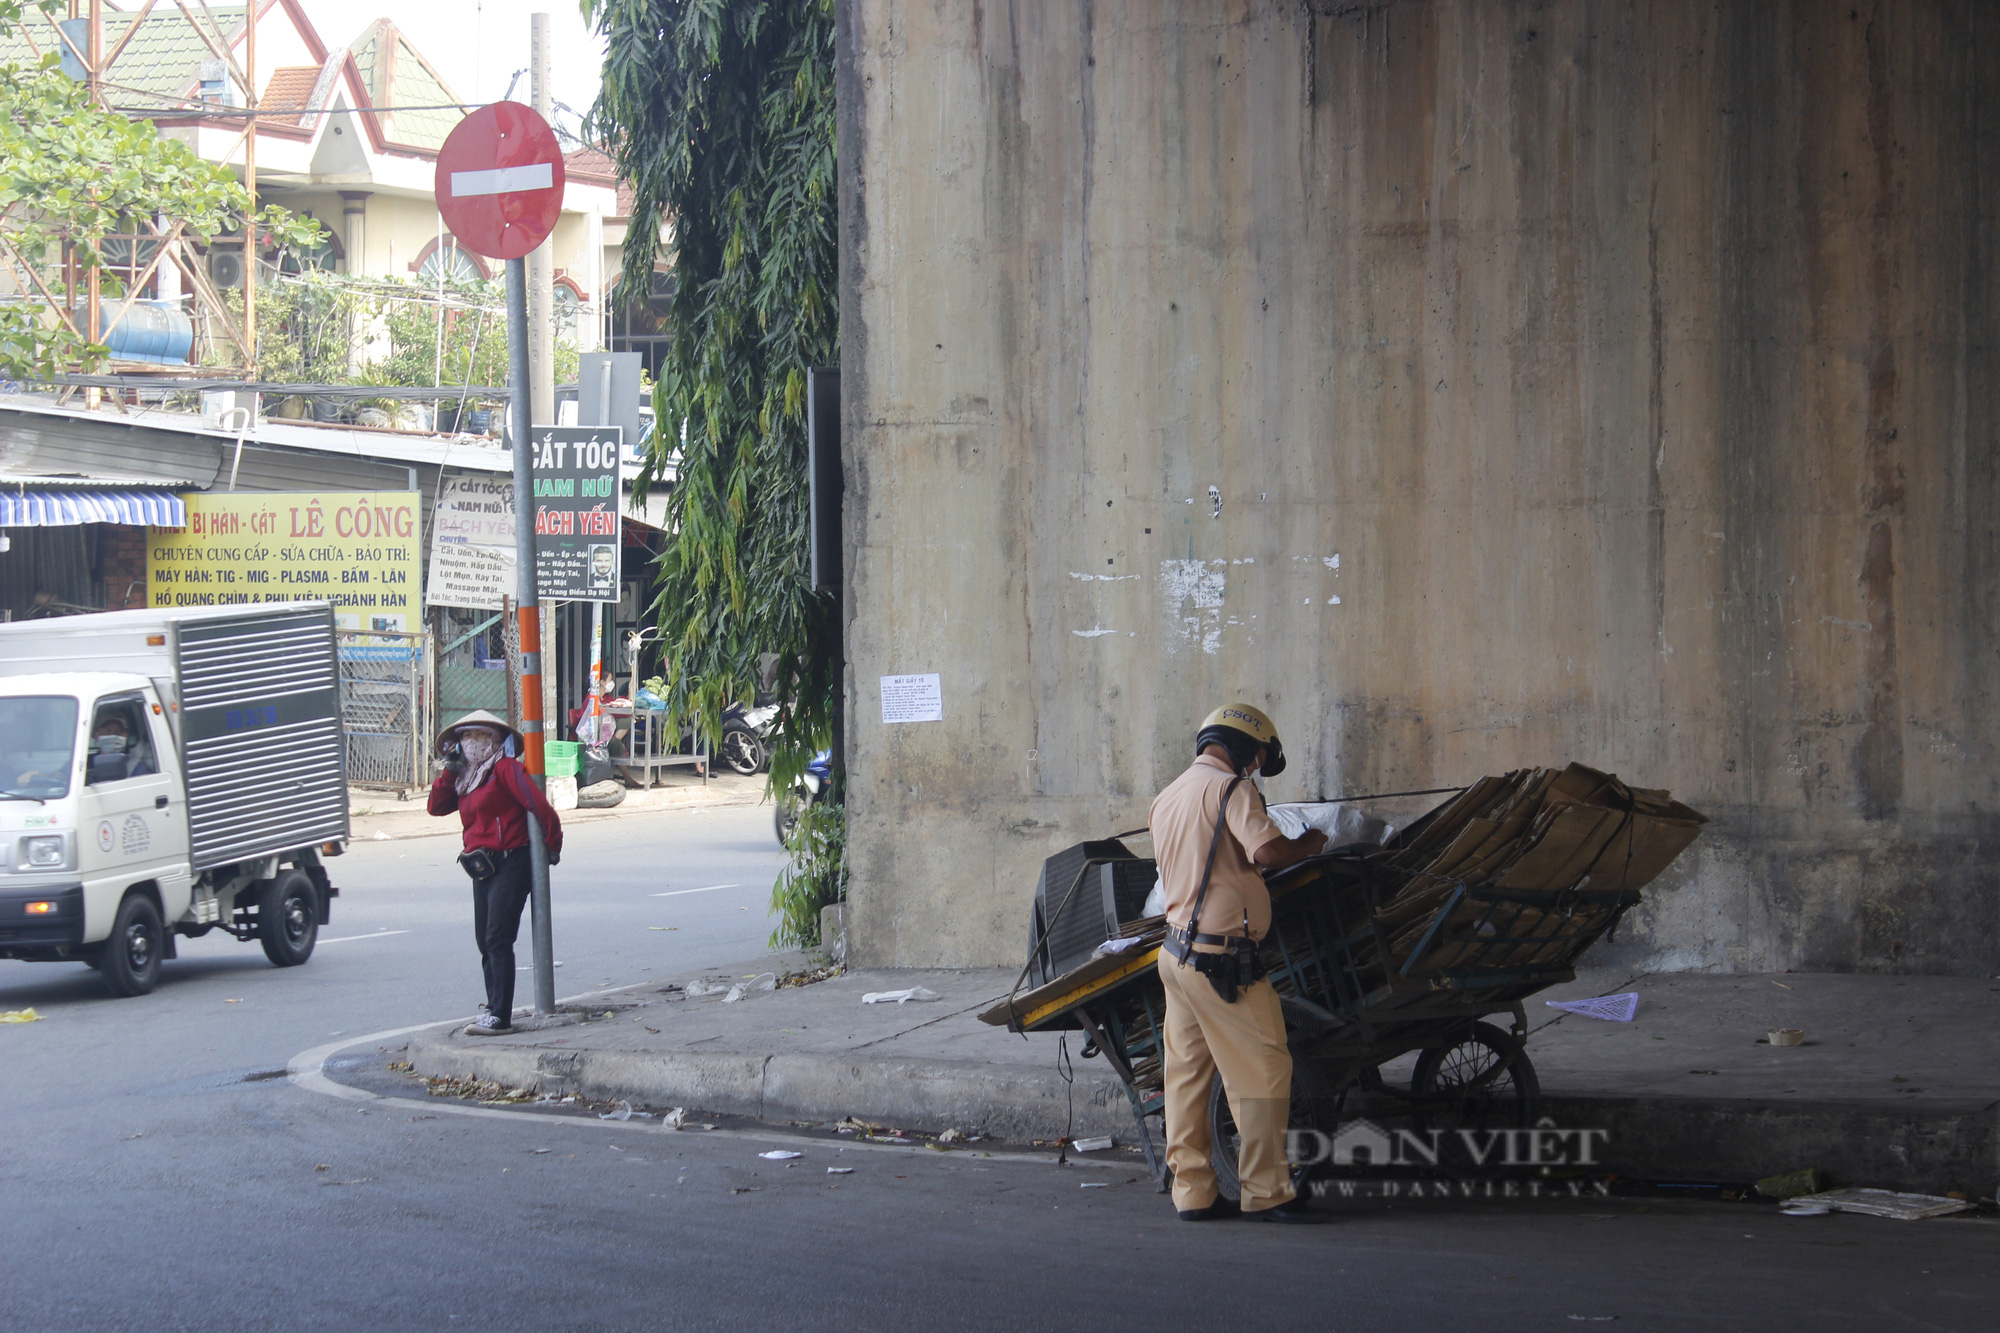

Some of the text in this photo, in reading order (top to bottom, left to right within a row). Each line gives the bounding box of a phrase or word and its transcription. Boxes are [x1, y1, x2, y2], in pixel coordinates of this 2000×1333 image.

[573, 434, 616, 469] TÓC
[581, 474, 614, 498] NỮ
[457, 501, 481, 513] NAM
[193, 512, 206, 540] BỊ
[211, 507, 239, 536] HÀN
[251, 503, 277, 536] CẮT
[289, 498, 325, 538] LÊ
[335, 497, 414, 538] CÔNG
[438, 515, 482, 533] BÁCH
[535, 505, 575, 535] ÁCH
[578, 502, 616, 536] YẾN
[153, 544, 203, 561] CHUYÊN
[206, 547, 241, 561] CUNG
[244, 542, 269, 561] CẤP
[280, 544, 306, 561] SỬA
[309, 544, 344, 561] CHỮA
[355, 543, 381, 561] BẢO
[155, 566, 181, 583] MÁY
[185, 566, 213, 583] HÀN:
[216, 570, 235, 583] TIG
[247, 570, 269, 583] MIG
[281, 570, 329, 583] PLASMA
[342, 565, 369, 584] BẤM
[381, 568, 406, 583] LĂN
[445, 582, 480, 593] Massage
[538, 588, 547, 596] óc
[548, 588, 568, 596] Trang
[175, 592, 215, 607] QUANG
[252, 593, 261, 604] &
[381, 590, 407, 607] HÀN
[1223, 708, 1262, 729] CSGT
